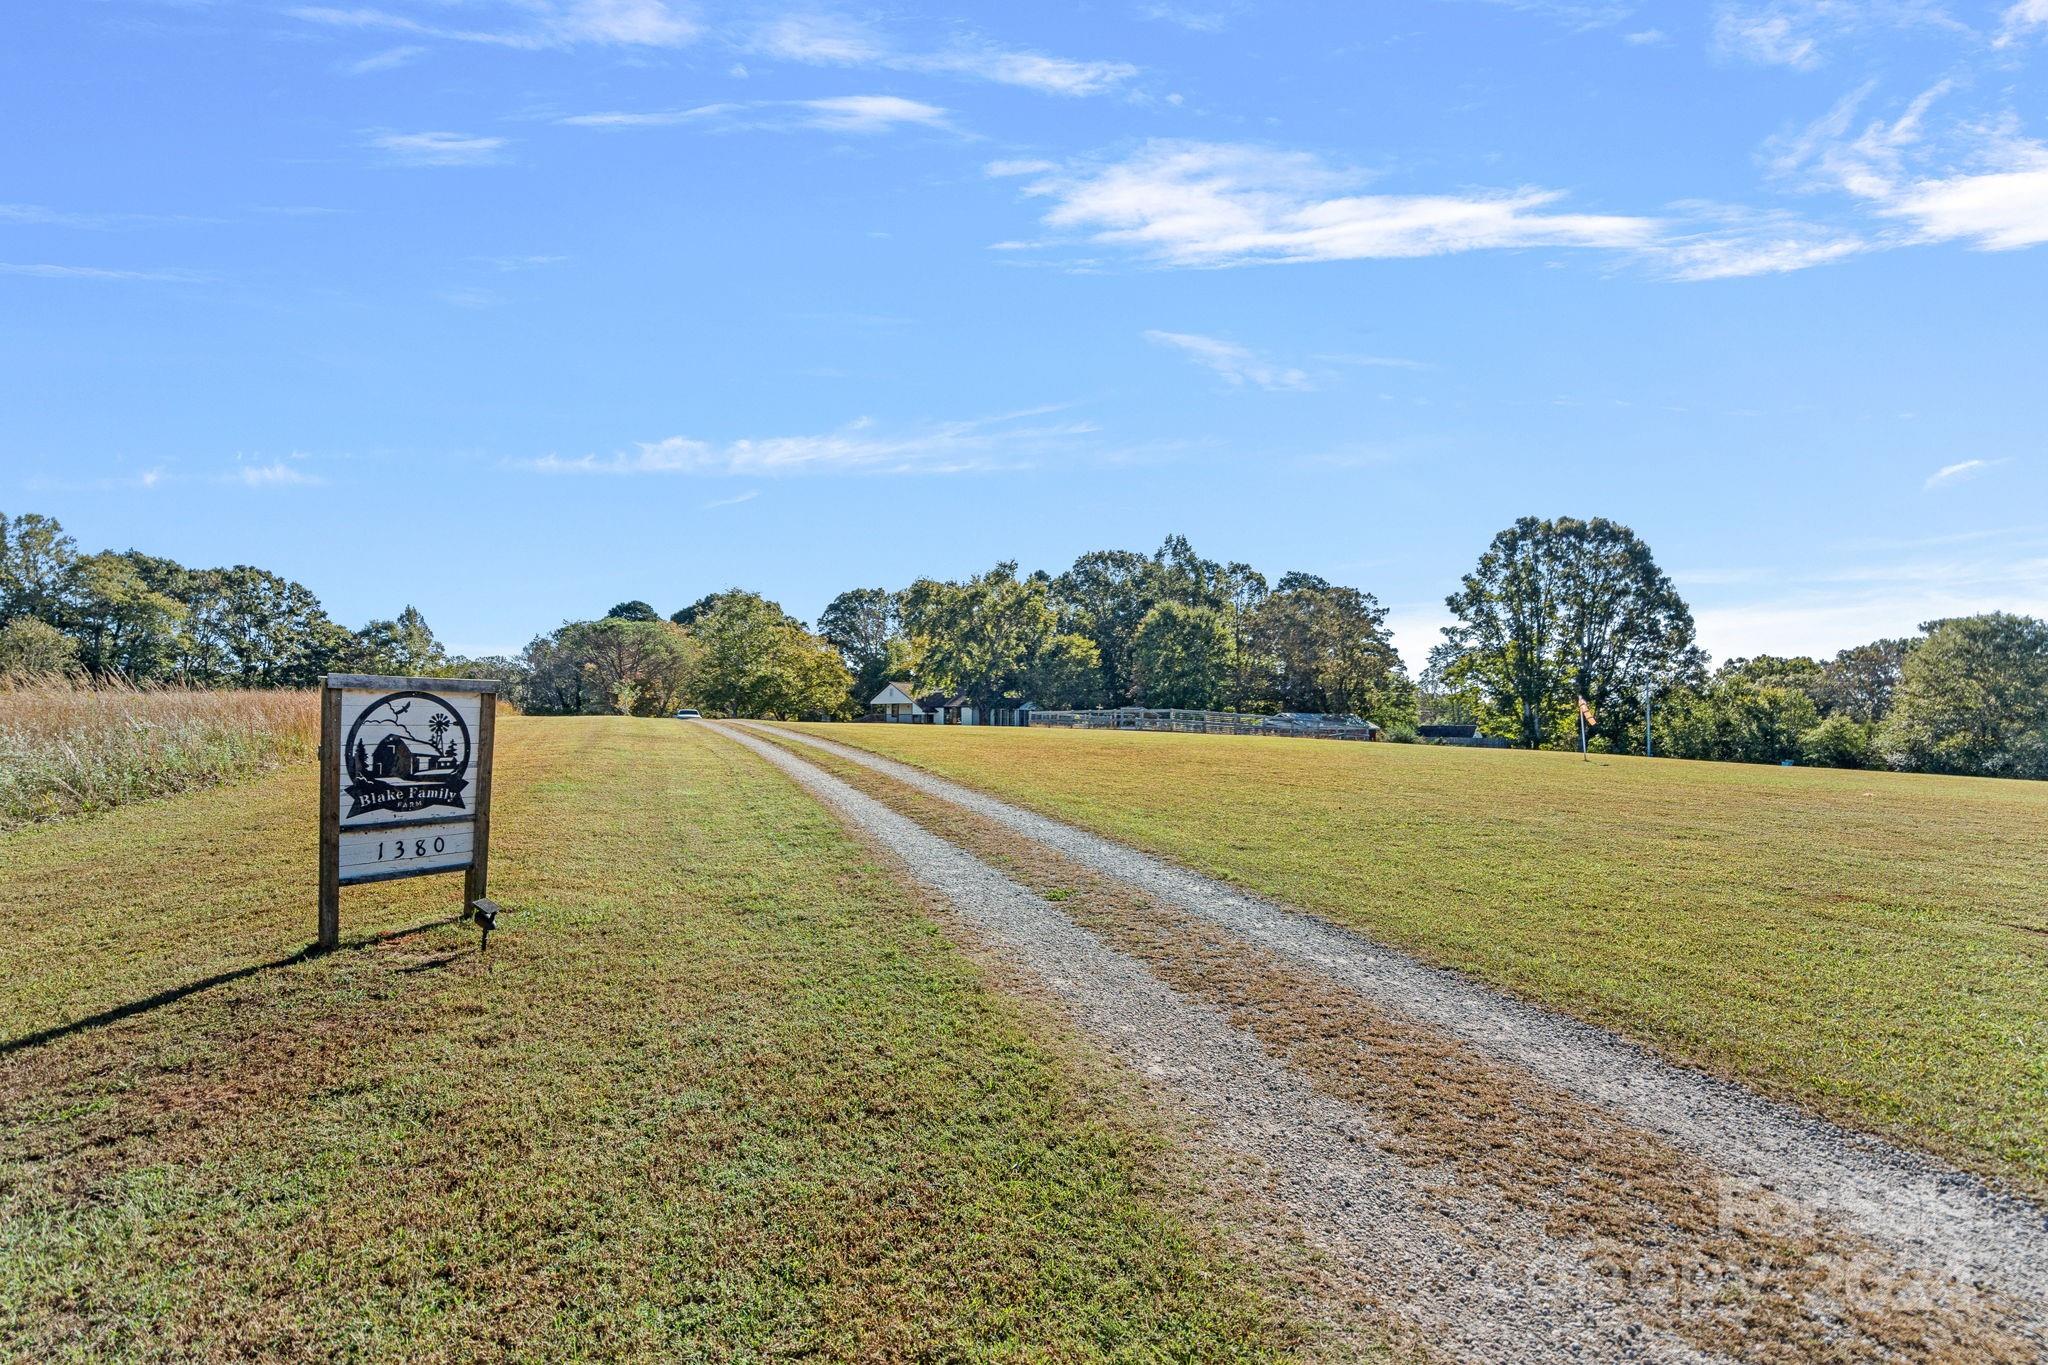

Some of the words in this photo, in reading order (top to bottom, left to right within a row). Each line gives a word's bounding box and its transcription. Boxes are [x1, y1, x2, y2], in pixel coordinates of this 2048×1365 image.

[360, 788, 404, 807] Blake
[408, 787, 457, 803] Family
[378, 837, 445, 860] 1380
